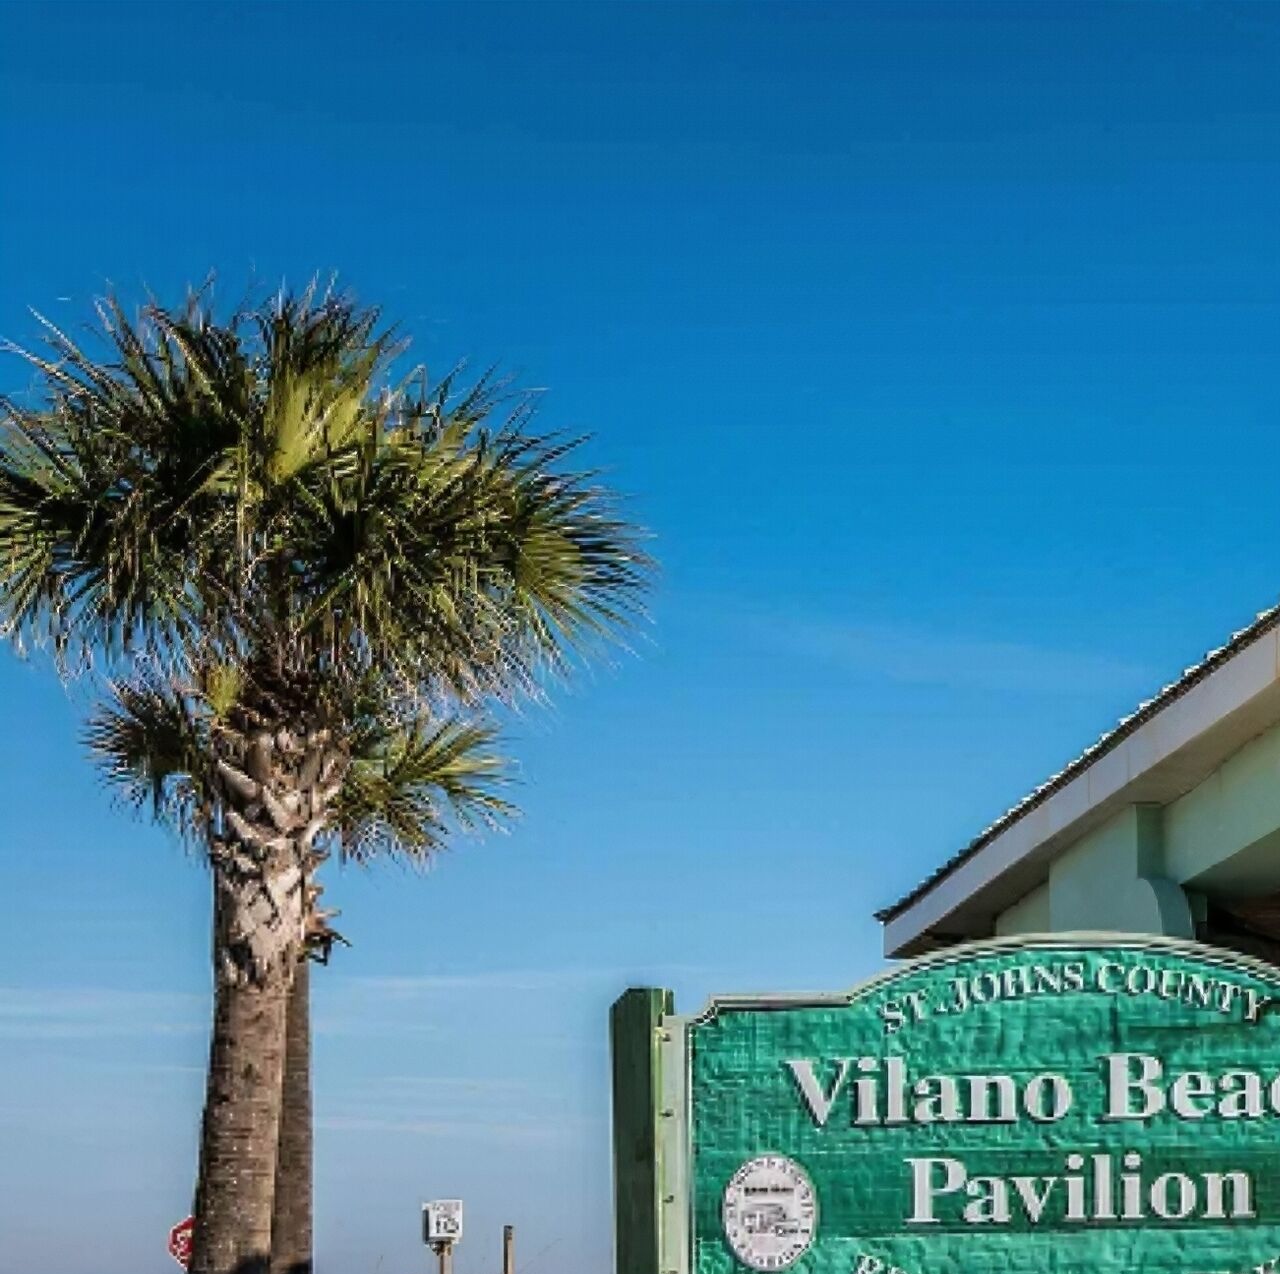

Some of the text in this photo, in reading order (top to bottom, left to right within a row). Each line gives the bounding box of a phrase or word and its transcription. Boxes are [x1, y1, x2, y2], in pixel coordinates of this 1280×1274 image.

[949, 961, 1086, 1014] JOHNS
[1098, 962, 1271, 1023] COUNTY
[786, 1055, 1073, 1127] Vilano
[902, 1153, 1257, 1225] Pavilion
